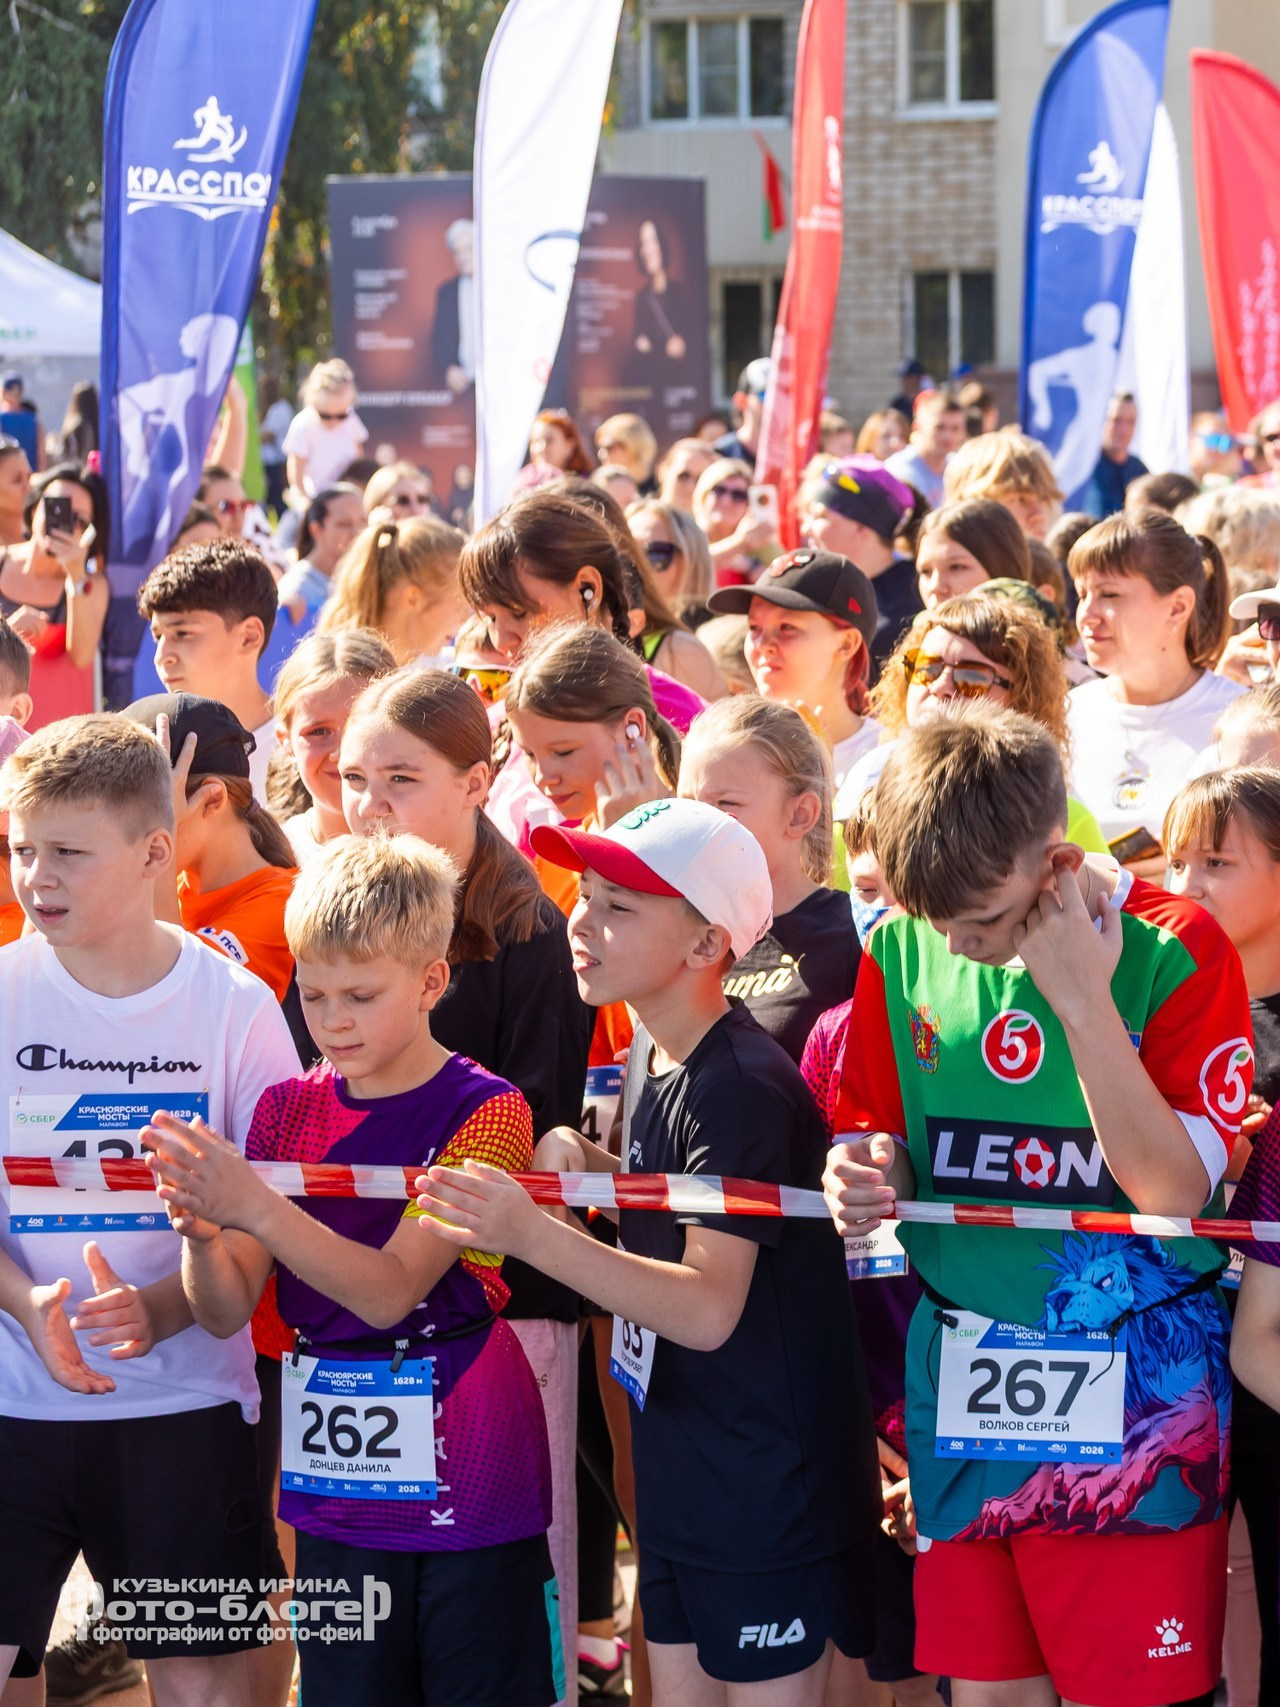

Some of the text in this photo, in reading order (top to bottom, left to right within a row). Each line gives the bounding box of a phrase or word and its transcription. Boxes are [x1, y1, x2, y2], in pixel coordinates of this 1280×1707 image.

[127, 165, 272, 197] КРАССПО
[721, 966, 794, 999] uma
[16, 1044, 202, 1084] Champion
[78, 1105, 149, 1114] КРАСНОЯРСКИЕ
[170, 1110, 191, 1118] 1628
[29, 1115, 56, 1123] СБЕР
[97, 1113, 130, 1121] МОСТЫ
[875, 1259, 892, 1268] 2026
[959, 1329, 980, 1338] СБЕР
[1014, 1331, 1046, 1340] МОСТЫ
[1086, 1331, 1109, 1340] 1628
[317, 1370, 373, 1380] КРАСНОЯРСКИЕ
[331, 1379, 357, 1387] МОСТЫ
[393, 1377, 414, 1385] 1628
[967, 1358, 1090, 1416] 267
[301, 1401, 402, 1458] 262
[979, 1420, 1070, 1432] ВОЛКОВ СЕРГЕЙ
[1079, 1446, 1104, 1455] 2026
[309, 1459, 392, 1474] ДОНЦЕВ ДАНИЛА
[398, 1485, 420, 1493] 2026
[738, 1617, 806, 1649] FILA
[1148, 1642, 1192, 1658] KELME
